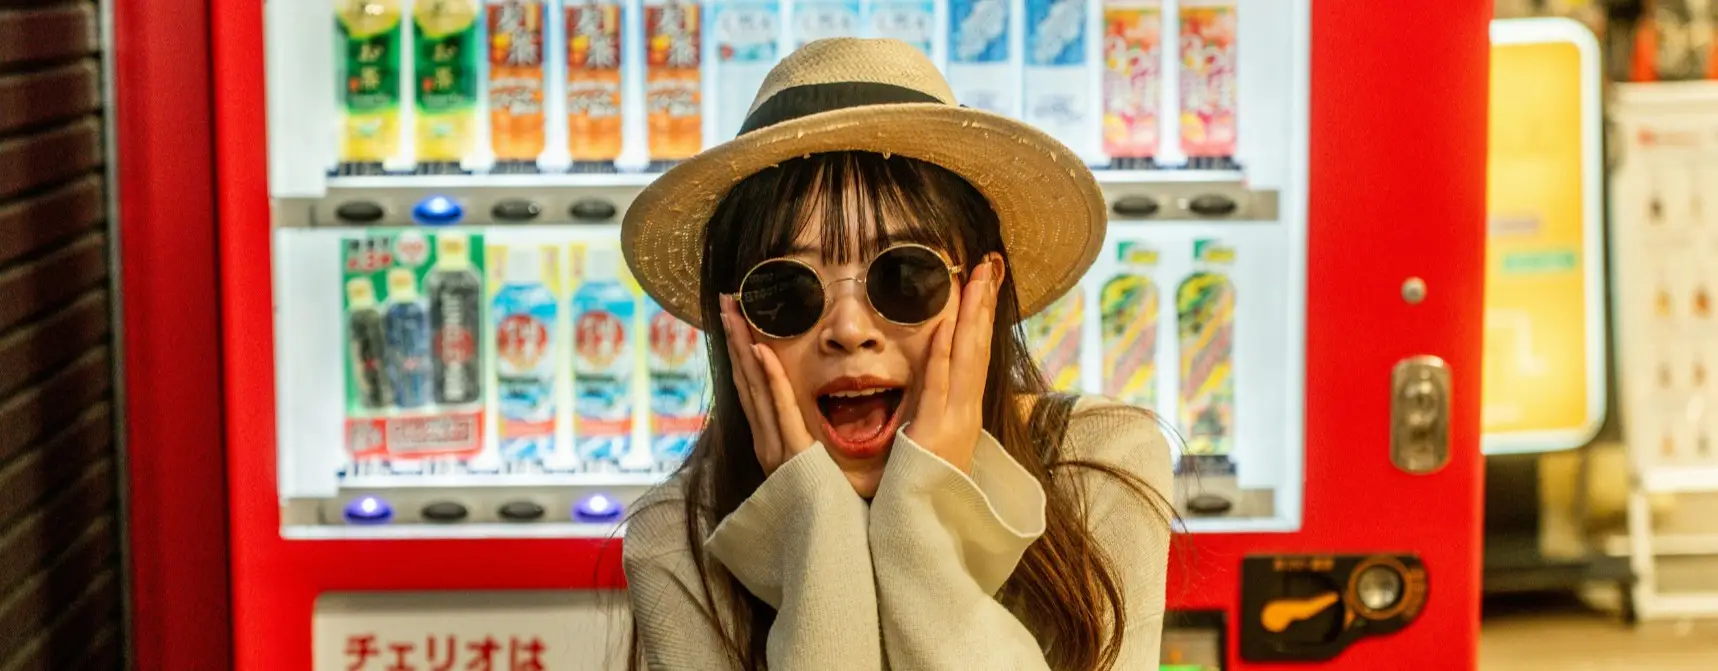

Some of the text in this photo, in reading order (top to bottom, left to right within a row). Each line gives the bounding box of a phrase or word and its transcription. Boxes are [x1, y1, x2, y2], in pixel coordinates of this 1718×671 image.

[344, 634, 547, 671] チェリオは
